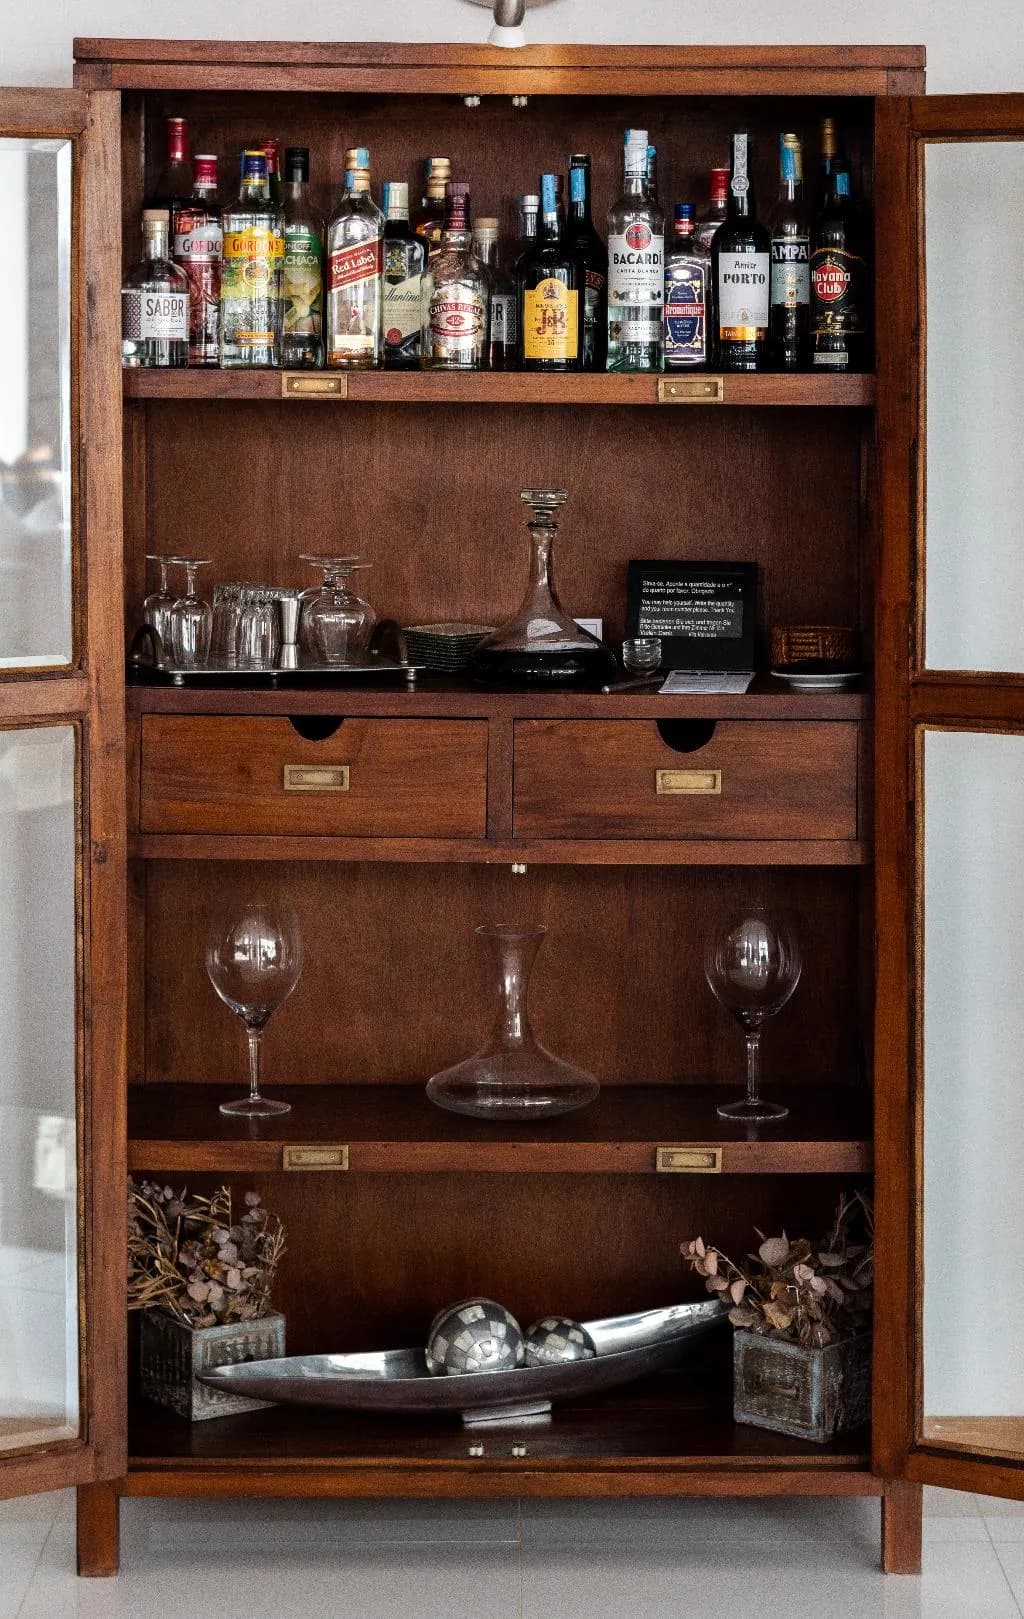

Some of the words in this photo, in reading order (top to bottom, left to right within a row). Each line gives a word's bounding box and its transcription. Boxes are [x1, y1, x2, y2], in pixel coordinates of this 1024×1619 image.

[232, 238, 281, 254] GORN'S
[332, 261, 350, 275] Red
[351, 252, 375, 269] Label
[723, 273, 766, 285] PORTO
[811, 270, 851, 282] Havana
[817, 282, 842, 294] Club
[146, 298, 184, 318] SABOR
[430, 303, 457, 315] CHIVAS
[457, 303, 481, 315] REGAL
[665, 304, 702, 316] Aromatique
[451, 316, 461, 325] 12
[824, 311, 834, 324] 7
